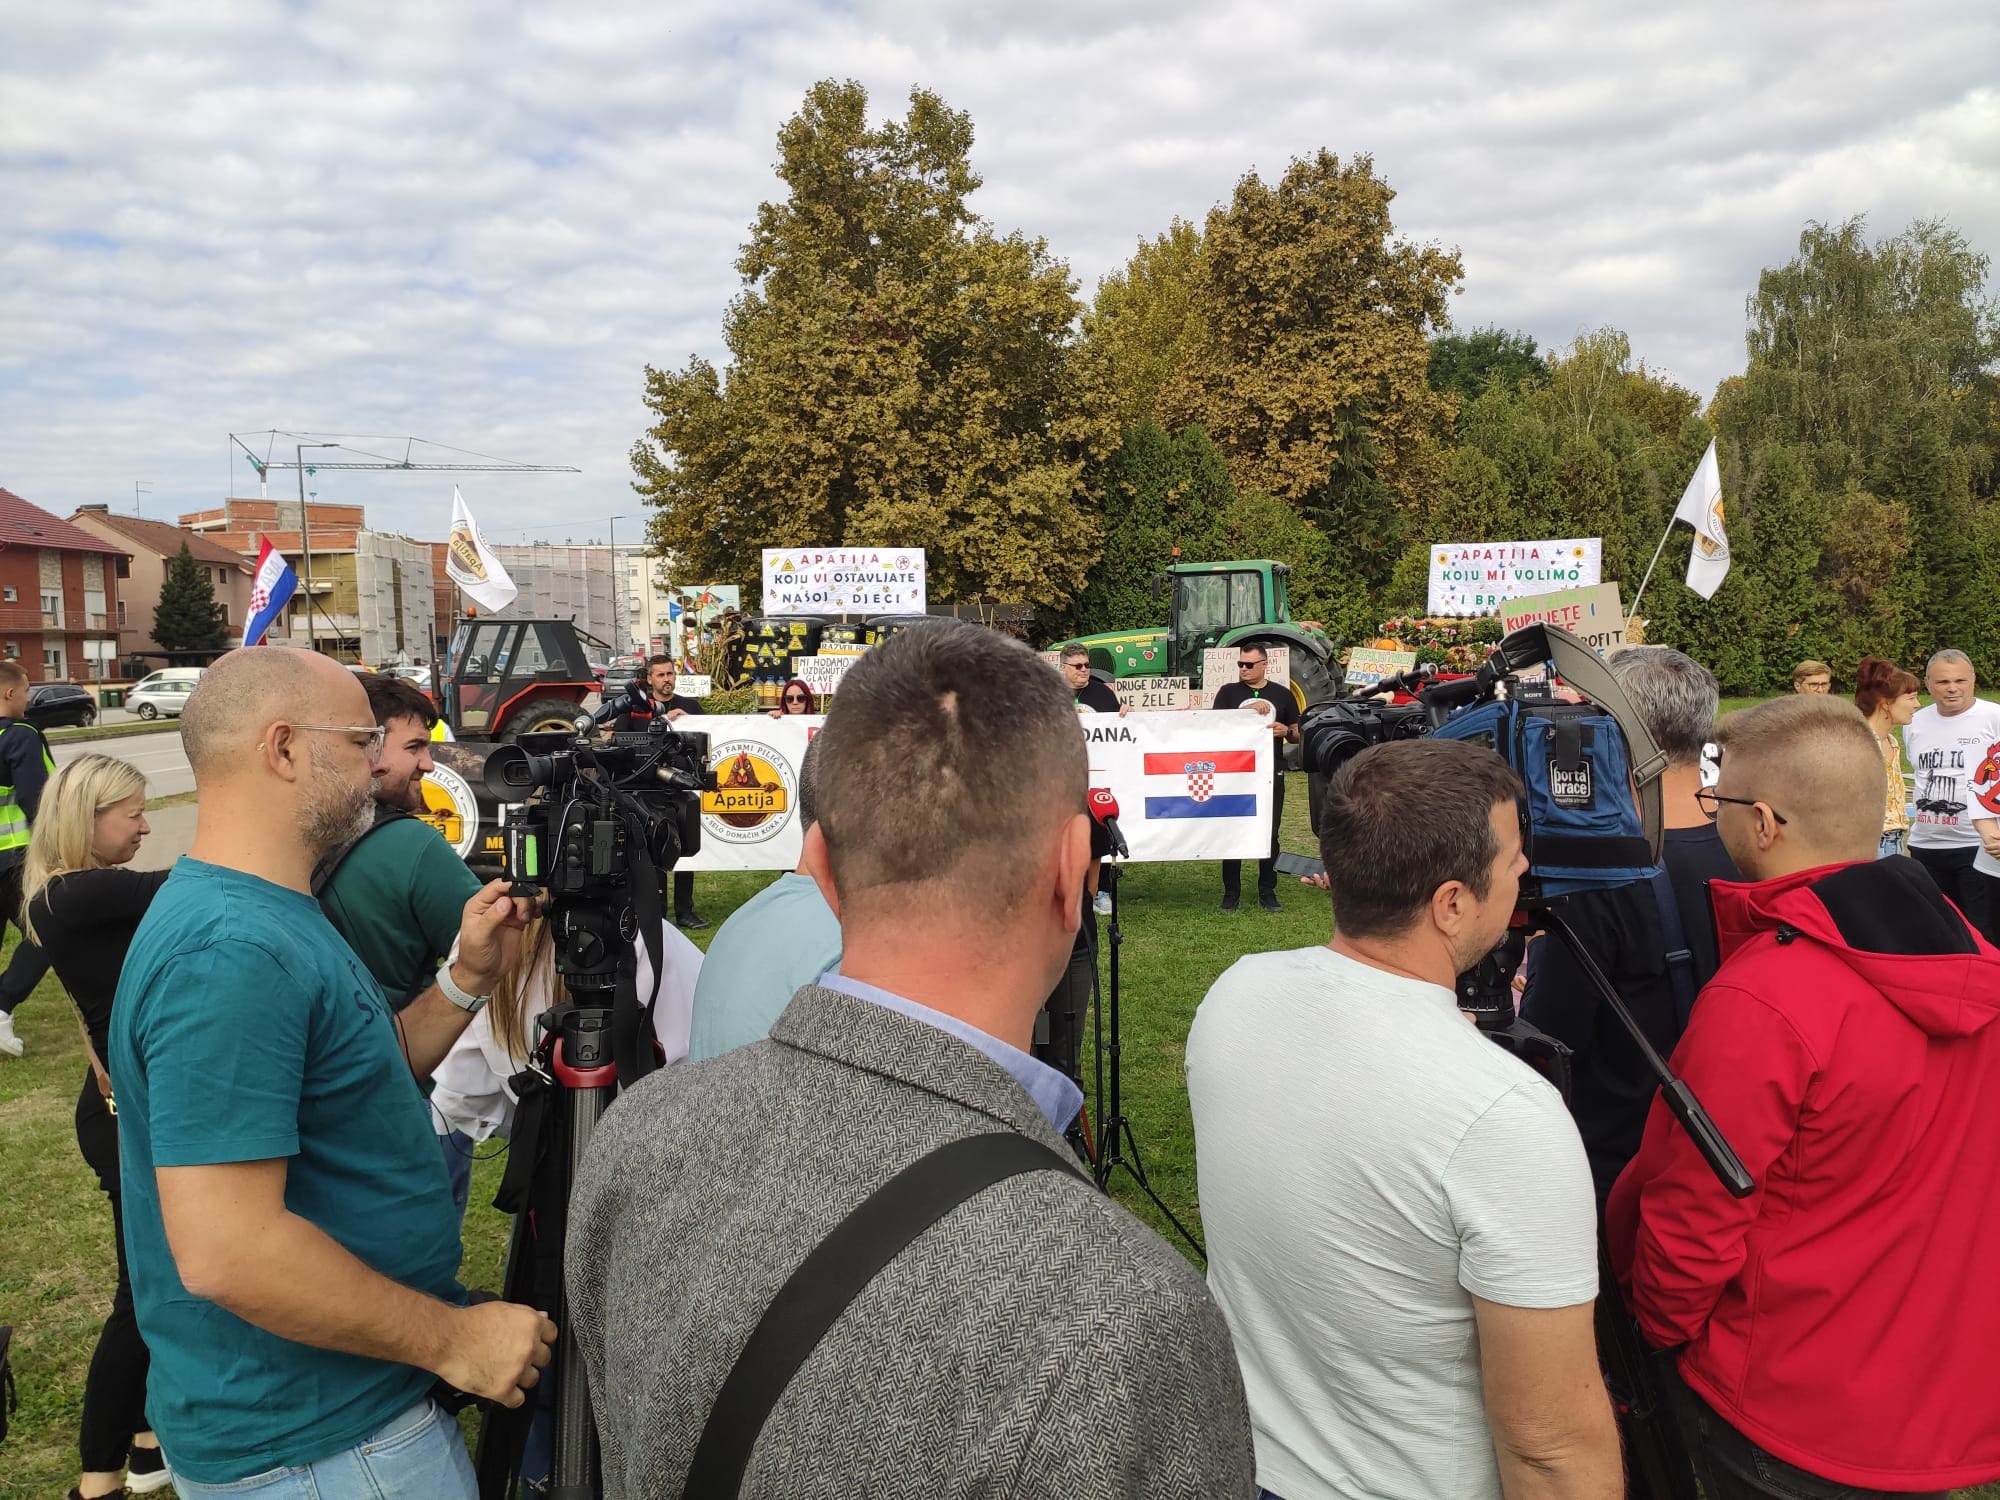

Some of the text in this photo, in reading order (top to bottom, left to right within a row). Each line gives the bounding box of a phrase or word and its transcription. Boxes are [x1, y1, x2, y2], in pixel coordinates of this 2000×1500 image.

[801, 554, 879, 565] APATIJA
[774, 571, 916, 585] KOJU VI OSTAVLJATE
[1487, 570, 1506, 580] MI
[1514, 569, 1580, 581] VOLIMO
[782, 590, 900, 604] NAŠOJ DJECI
[813, 657, 850, 668] HODAMO
[802, 667, 845, 675] UZDIGNUTE
[820, 682, 832, 693] VI
[1116, 679, 1147, 692] DRUGE
[1119, 695, 1135, 707] NE
[1141, 692, 1175, 707] ŽELE
[725, 743, 753, 753] FARMI
[1553, 782, 1588, 795] brace
[713, 792, 774, 809] Apatija
[708, 820, 724, 834] SELO
[761, 820, 780, 835] KOKA
